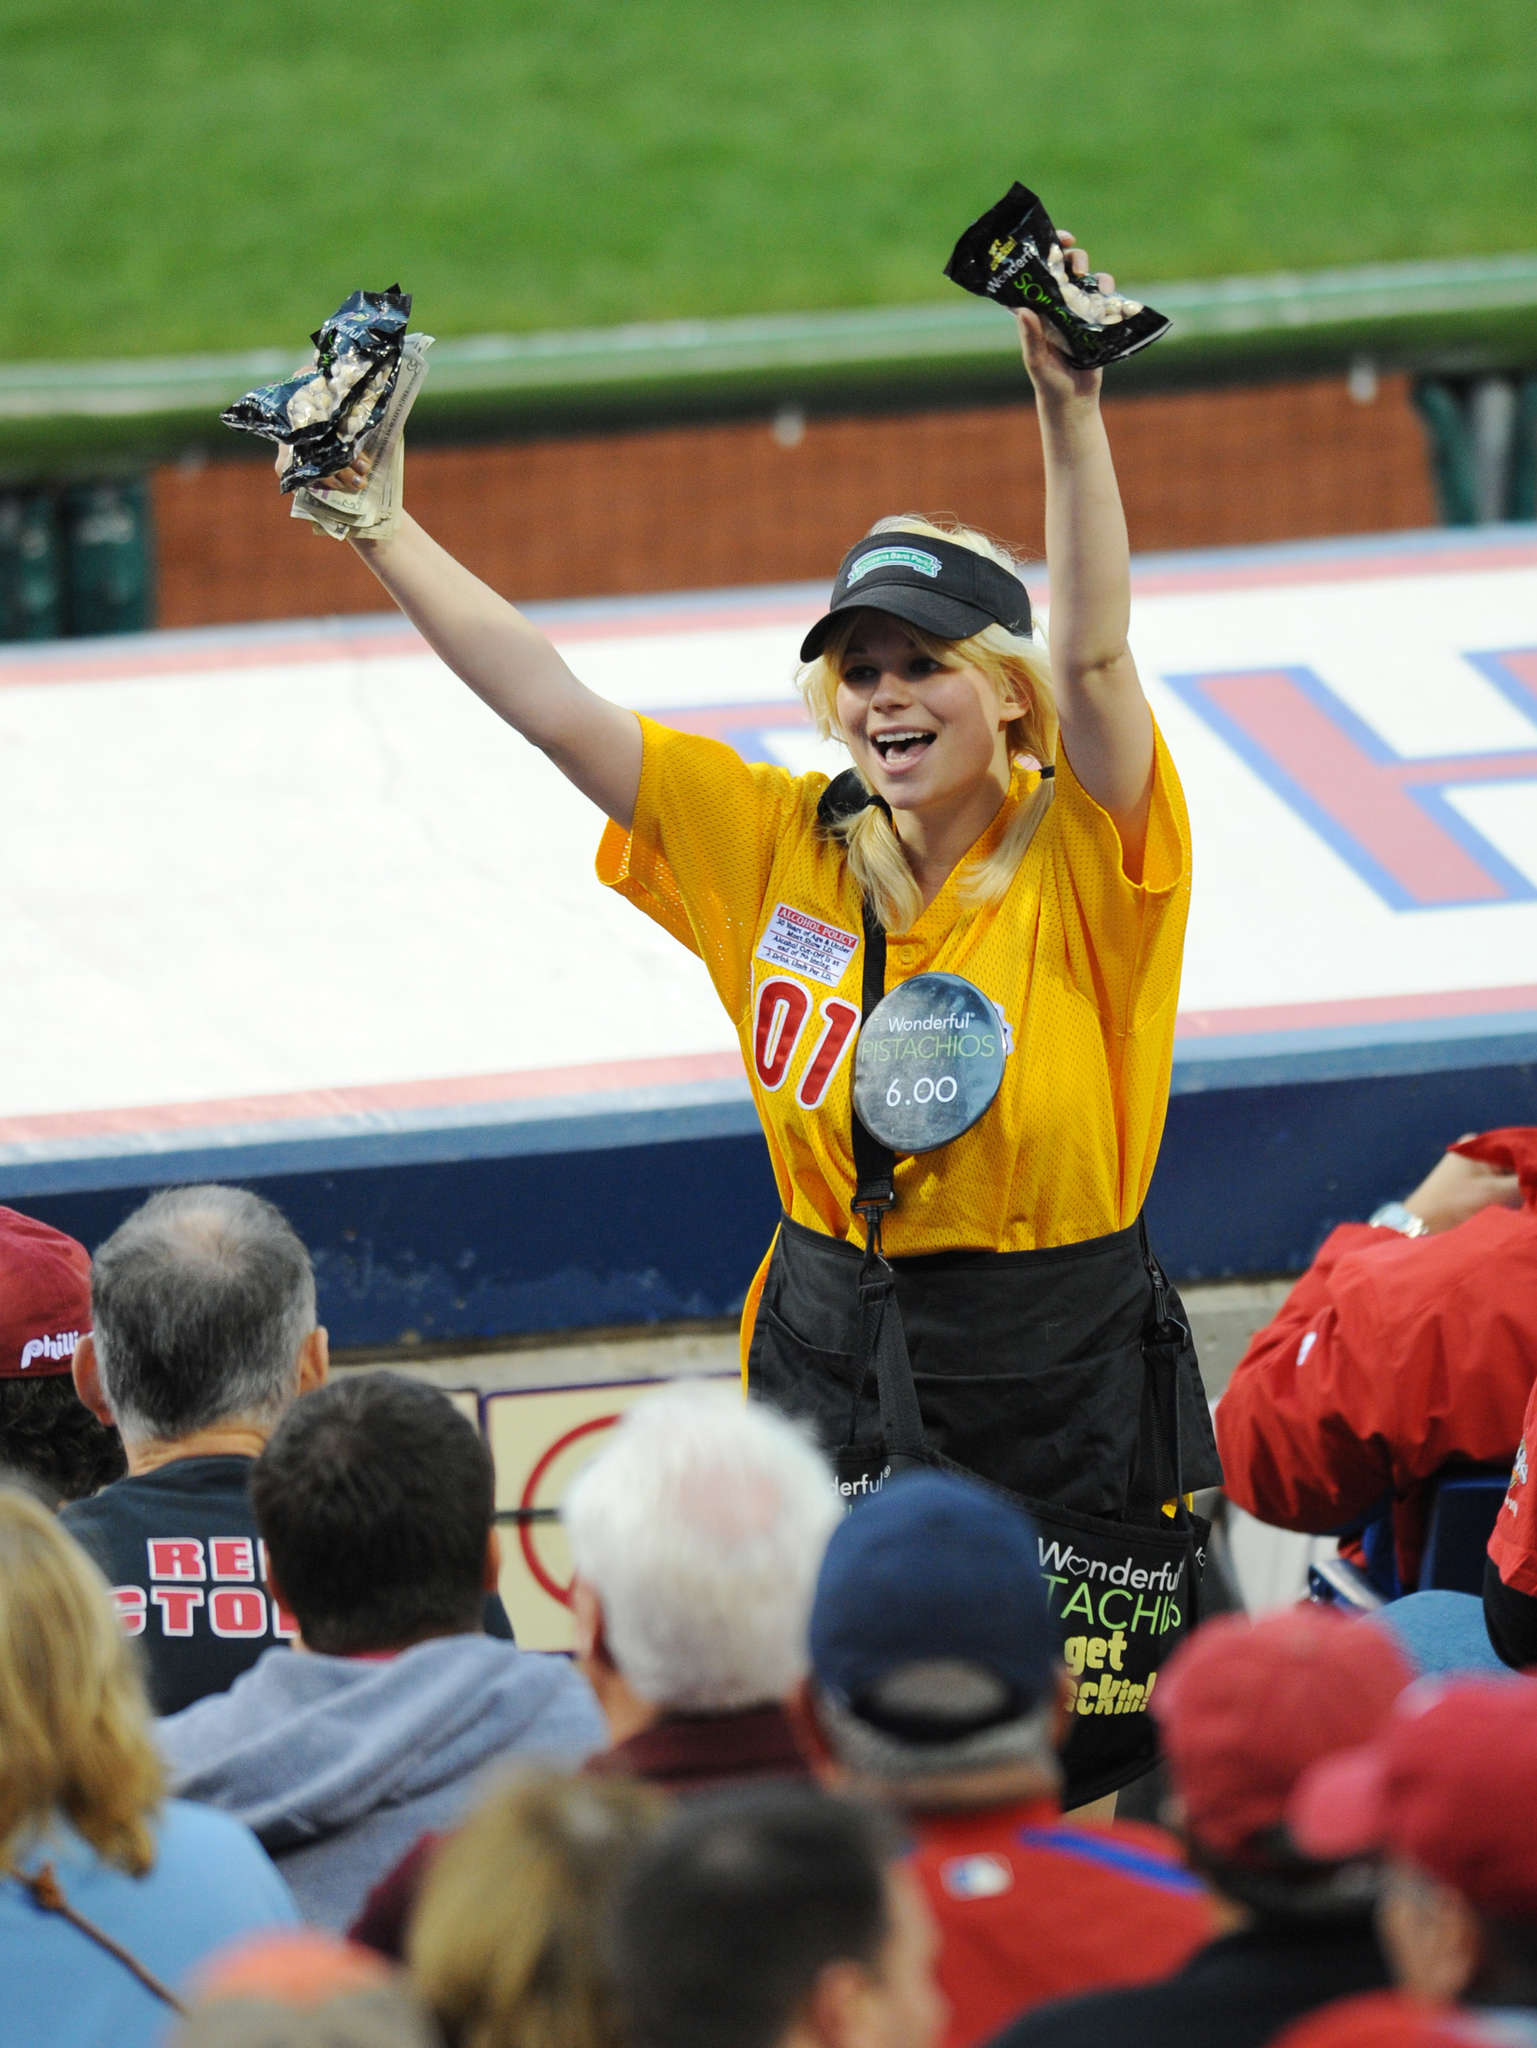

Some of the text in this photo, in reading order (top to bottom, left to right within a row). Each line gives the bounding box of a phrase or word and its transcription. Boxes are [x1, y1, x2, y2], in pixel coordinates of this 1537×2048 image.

[780, 908, 857, 947] ALCOHOL POLICY
[888, 1012, 970, 1033] Wonderful
[754, 975, 862, 1110] 01
[861, 1034, 995, 1063] PISTACHIOS
[886, 1076, 957, 1107] 6.00
[21, 1330, 80, 1370] philli
[147, 1537, 267, 1582] RE
[1064, 1630, 1127, 1676] get
